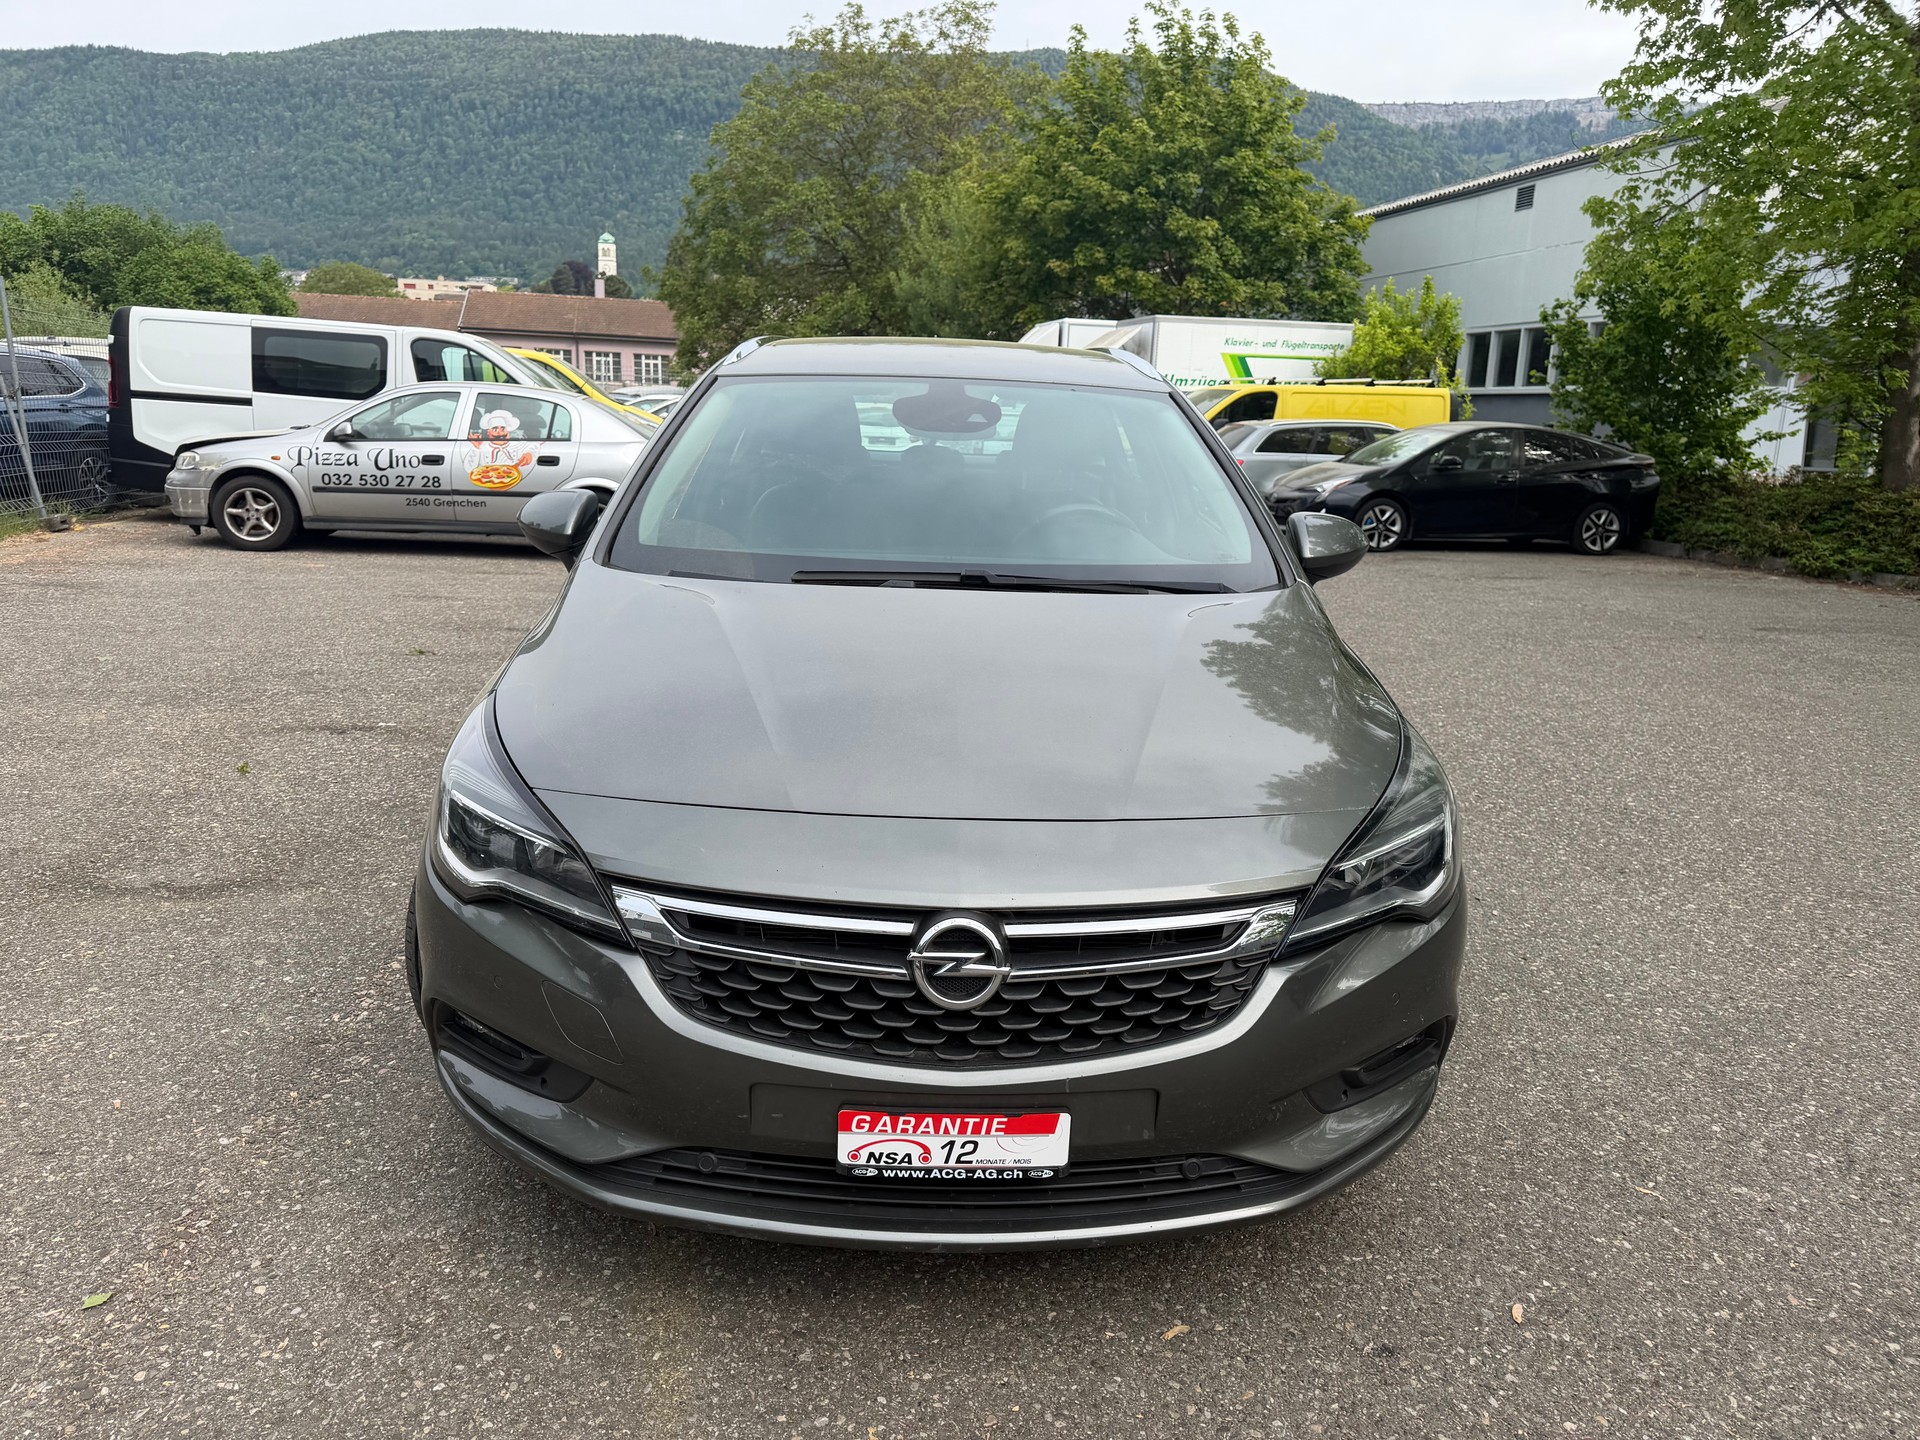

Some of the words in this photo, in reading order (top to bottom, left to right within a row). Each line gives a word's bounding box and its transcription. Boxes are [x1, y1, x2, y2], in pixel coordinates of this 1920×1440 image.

[1262, 340, 1277, 348] und
[1281, 340, 1345, 351] Flügeltransporte
[287, 446, 359, 473] Pizza
[366, 448, 421, 471] Uno
[321, 473, 353, 486] 032
[358, 474, 389, 487] 530
[395, 475, 415, 487] 27
[421, 476, 442, 488] 28
[405, 497, 431, 507] 2540
[433, 498, 487, 508] Grenchen
[851, 1114, 1008, 1136] GARANTIE
[865, 1151, 913, 1165] NSA
[940, 1140, 979, 1164] 12
[882, 1168, 1023, 1179] www.ACG-AG.ch
